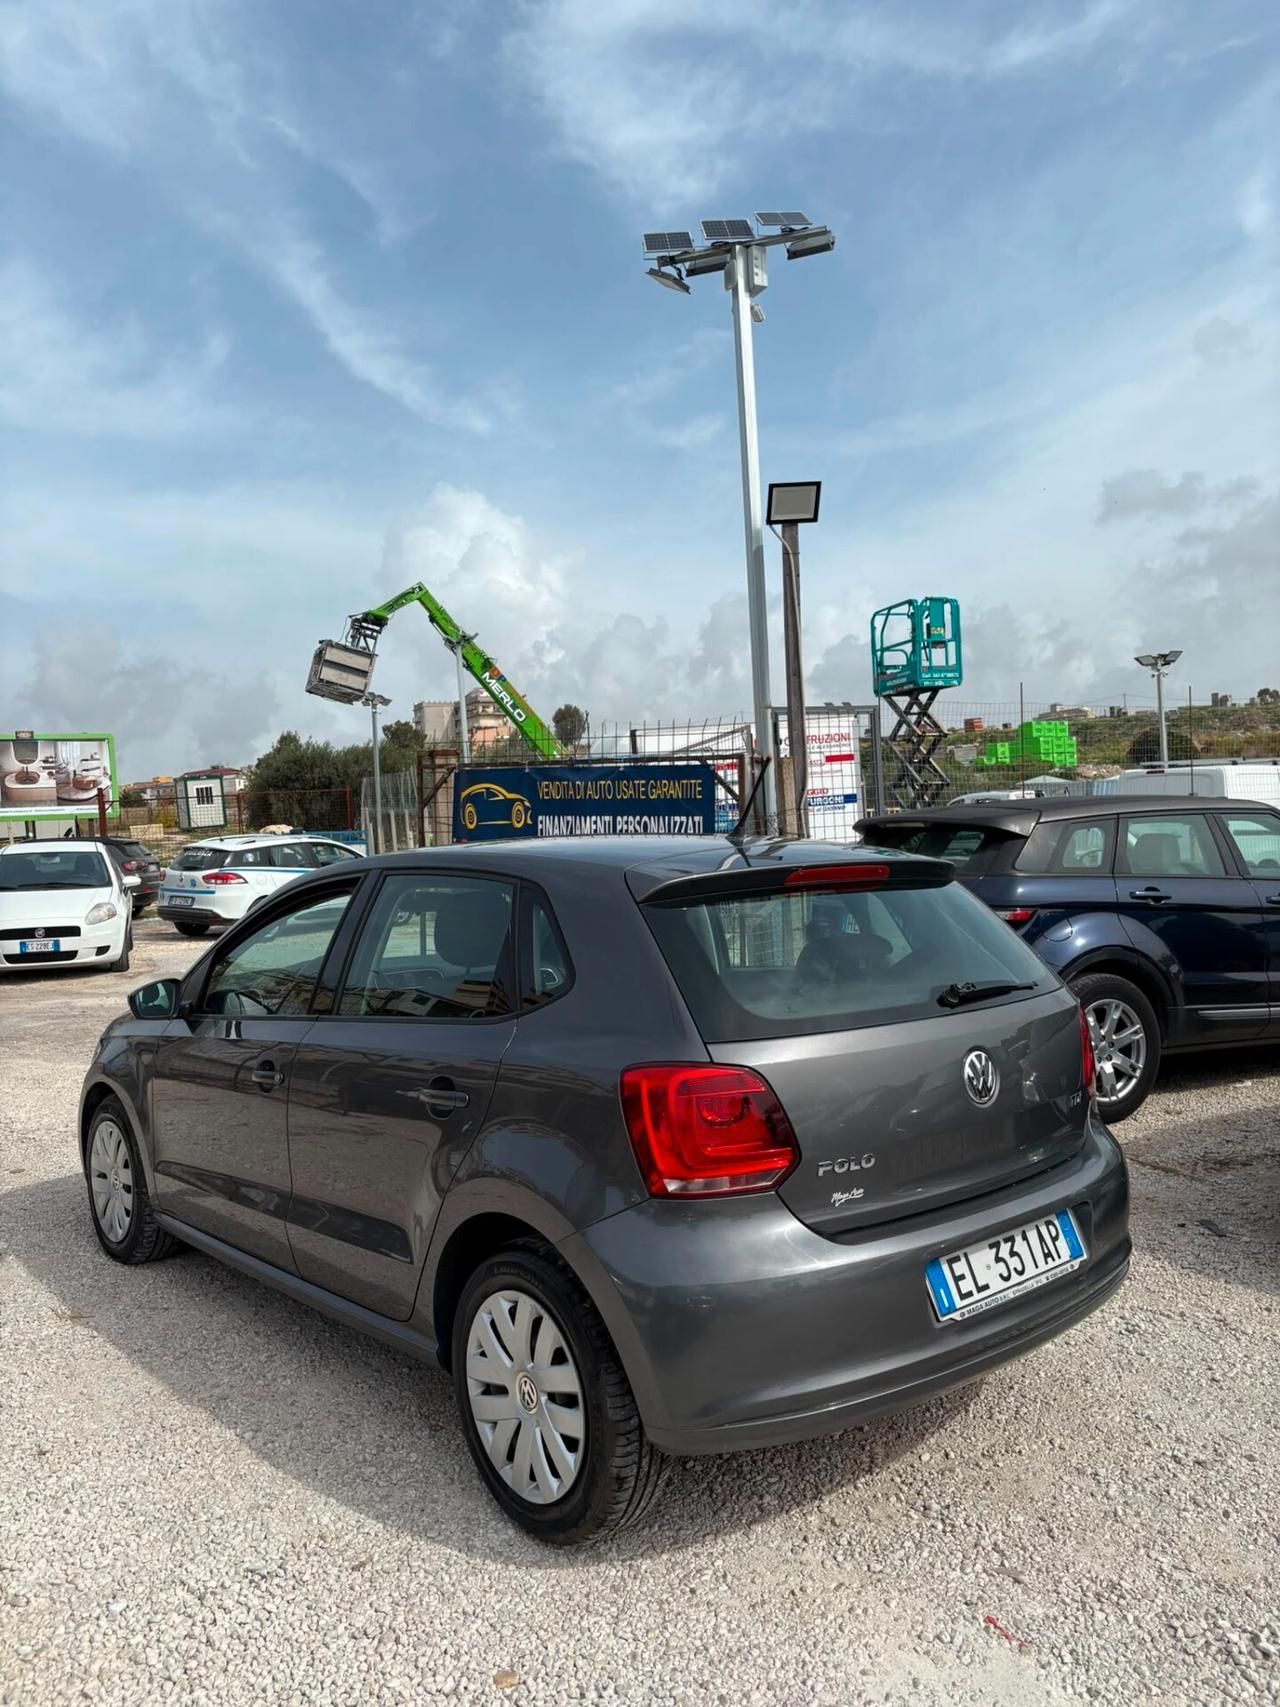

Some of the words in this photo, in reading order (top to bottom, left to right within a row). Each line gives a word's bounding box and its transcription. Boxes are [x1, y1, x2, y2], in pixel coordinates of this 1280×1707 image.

[482, 672, 526, 722] MERLO
[537, 780, 575, 800] VENDITA
[575, 780, 585, 800] DI
[586, 780, 614, 800] AUTO
[615, 780, 646, 800] USATE
[648, 779, 703, 799] GARANTITE
[537, 815, 613, 837] FINANZIAMENTI
[616, 815, 703, 834] PERSONALIZZATI
[818, 1153, 876, 1177] POLO
[946, 1252, 991, 1301] EL
[988, 1219, 1061, 1282] 331AP
[984, 1296, 1000, 1309] AUTO
